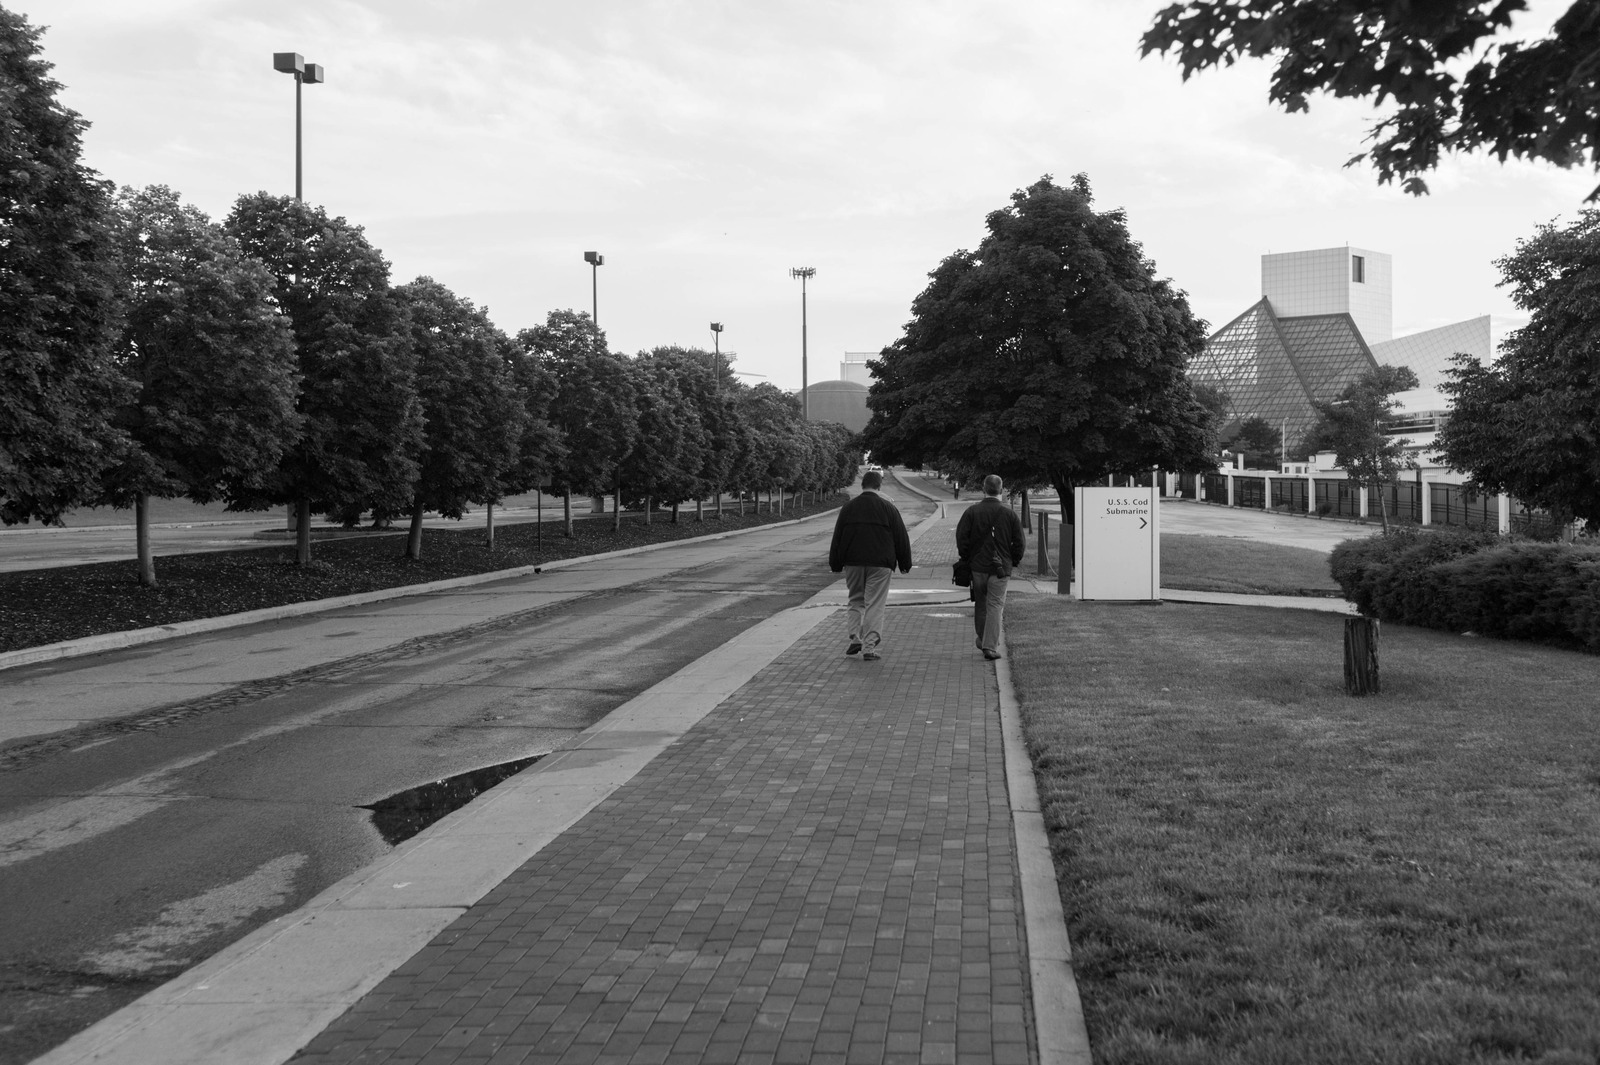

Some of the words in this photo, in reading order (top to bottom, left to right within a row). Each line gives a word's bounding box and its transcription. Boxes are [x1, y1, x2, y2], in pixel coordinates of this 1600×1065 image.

[1107, 498, 1131, 506] U.S.S.
[1132, 498, 1148, 506] Cod
[1106, 507, 1148, 515] Submarine
